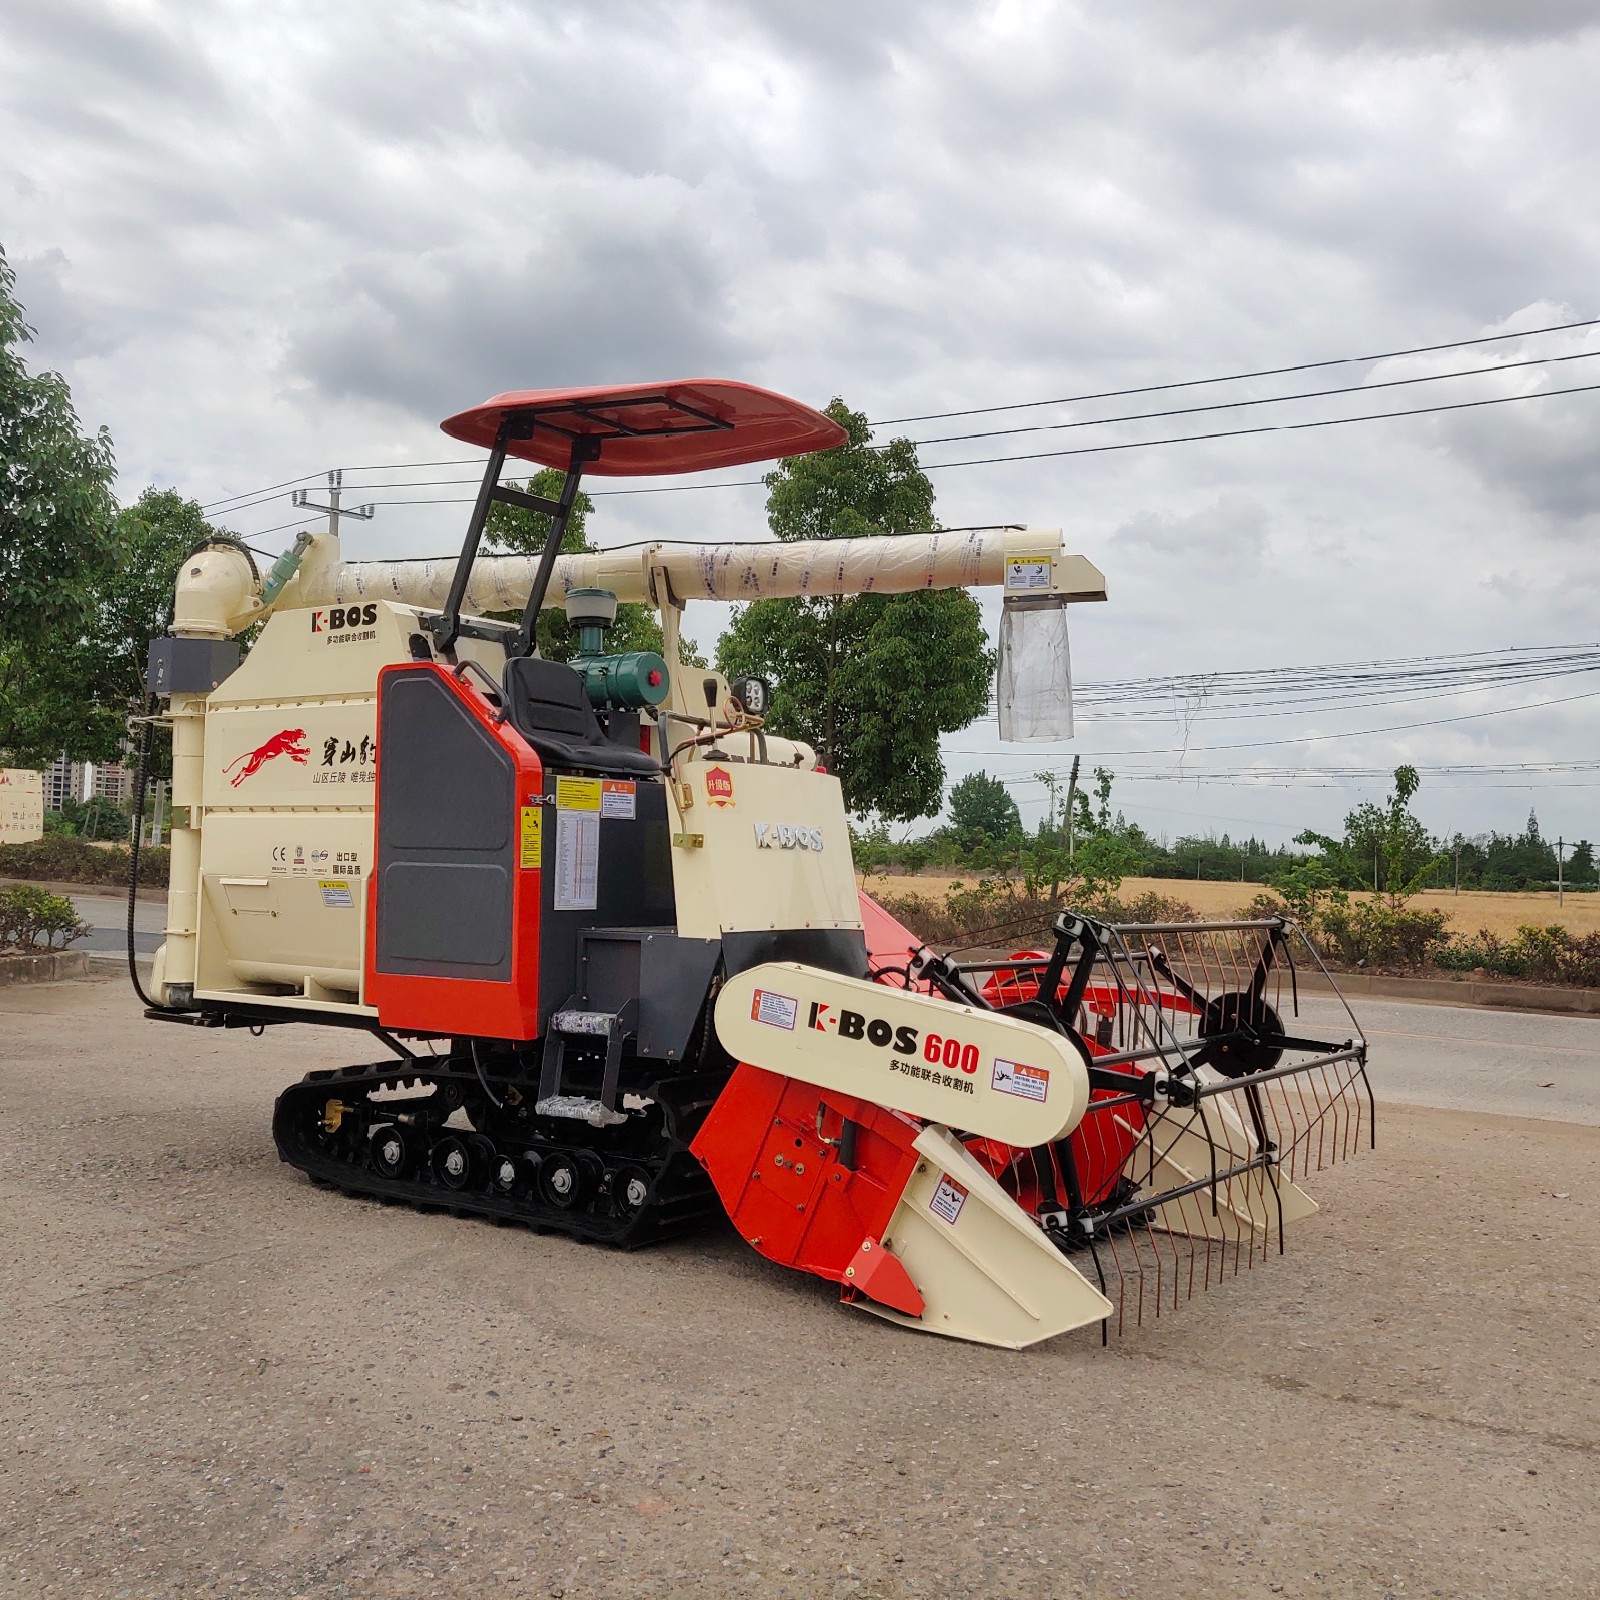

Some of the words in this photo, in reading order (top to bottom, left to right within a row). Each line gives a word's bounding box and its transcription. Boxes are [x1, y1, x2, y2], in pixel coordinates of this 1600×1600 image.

[312, 604, 377, 632] K-BOS
[327, 631, 376, 645] 多功能联合收割机
[313, 772, 346, 784] 山区丘陵
[708, 779, 731, 791] 升级版
[754, 823, 824, 852] K-BOS
[336, 852, 358, 862] 出口型
[333, 865, 361, 875] 国际品质
[808, 1001, 919, 1055] K-BOS
[924, 1034, 980, 1075] 600
[889, 1059, 974, 1095] 多功能联合收割机
